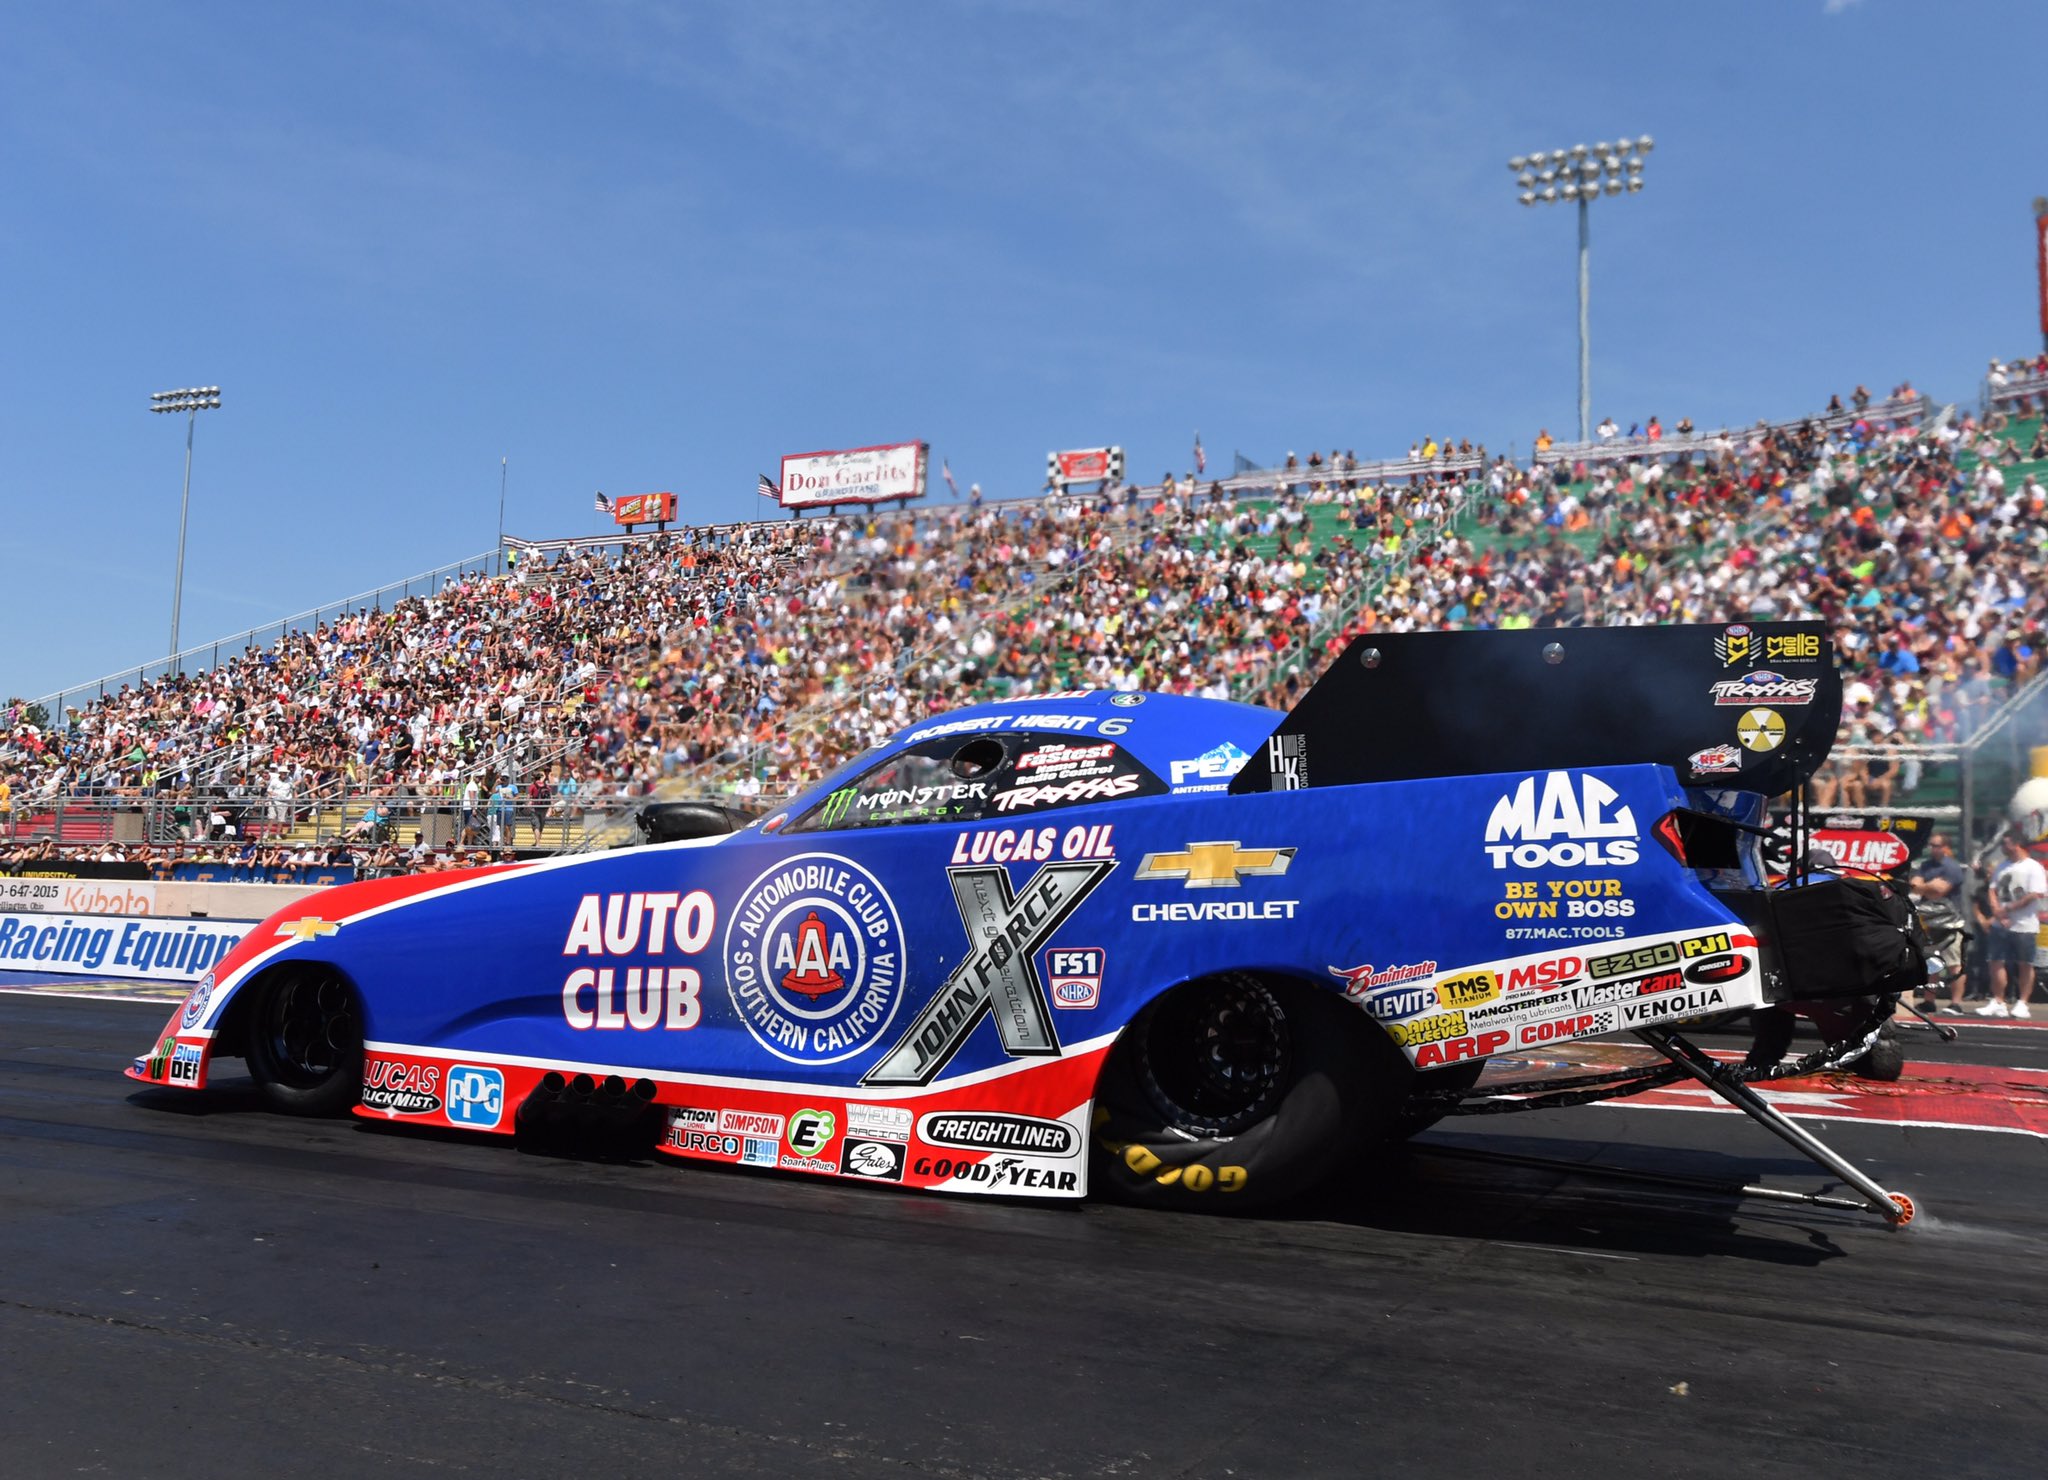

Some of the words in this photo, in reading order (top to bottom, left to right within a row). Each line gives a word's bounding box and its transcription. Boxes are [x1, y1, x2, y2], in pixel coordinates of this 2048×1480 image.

[789, 472, 830, 491] Don
[1713, 680, 1815, 697] TRAXXAS
[904, 715, 1013, 743] ROBERT
[1011, 715, 1097, 730] HIGHT
[1098, 718, 1133, 735] 6
[1015, 744, 1116, 769] Fastest
[1298, 734, 1309, 788] ONSTRUCTION
[1059, 765, 1115, 779] Control
[992, 774, 1140, 812] TRAXXAS
[870, 806, 964, 820] ENERGY
[1485, 771, 1638, 842] MAC
[951, 827, 1057, 864] LUCAS
[1485, 840, 1640, 869] TOOLS
[1505, 882, 1538, 899] BE
[1547, 879, 1622, 898] YOUR
[739, 866, 850, 938] AUTOMOBILE
[848, 883, 889, 938] CLUB
[1132, 901, 1300, 922] CHEVROLET
[1495, 901, 1558, 919] OWN
[1567, 899, 1635, 918] BOSS
[563, 889, 717, 956] AUTO
[1505, 926, 1625, 939] 877.MAC.TOOLS
[0, 917, 114, 969] Racing
[774, 928, 851, 978] AAA
[1684, 935, 1728, 957] PJ1
[1054, 953, 1097, 974] FS1
[1591, 943, 1677, 977] EZGO
[913, 976, 978, 1073] JOHN
[974, 874, 1063, 989] FORCE
[1508, 957, 1582, 991] MSD
[562, 967, 703, 1031] CLUB
[1060, 984, 1092, 1000] NHRA
[1443, 976, 1490, 999] TMS
[1450, 992, 1492, 1006] TITANIUM
[1575, 971, 1682, 1009] Mastercam
[734, 951, 808, 1051] SOUTHERN
[813, 952, 895, 1052] CALIFORNIA
[1362, 988, 1436, 1018] CLEVITE
[1469, 992, 1568, 1020] HANGSTERFER'S
[1624, 989, 1724, 1021] VENOLIA
[1471, 1012, 1528, 1030] Metalworking
[1529, 1003, 1572, 1018] Lubricants
[1645, 1013, 1675, 1024] FORGED
[1677, 1006, 1708, 1018] PISTONS
[1408, 1022, 1468, 1046] SLEEVES
[1521, 1014, 1594, 1044] COMP
[1573, 1025, 1609, 1038] CAMS
[174, 1045, 201, 1061] Blue
[1415, 1030, 1510, 1067] ARP
[363, 1059, 440, 1095] LUCAS
[449, 1072, 500, 1119] PPG
[675, 1108, 715, 1123] ACTION
[686, 1122, 706, 1130] LIONEL
[723, 1113, 780, 1135] SIMPSON
[846, 1104, 913, 1128] WELD
[666, 1129, 739, 1154] HURCO
[848, 1127, 909, 1140] RACING
[932, 1119, 1066, 1149] FREIGHTLINER
[781, 1156, 807, 1168] Spark
[810, 1159, 836, 1171] Plugs
[849, 1146, 893, 1170] Gates
